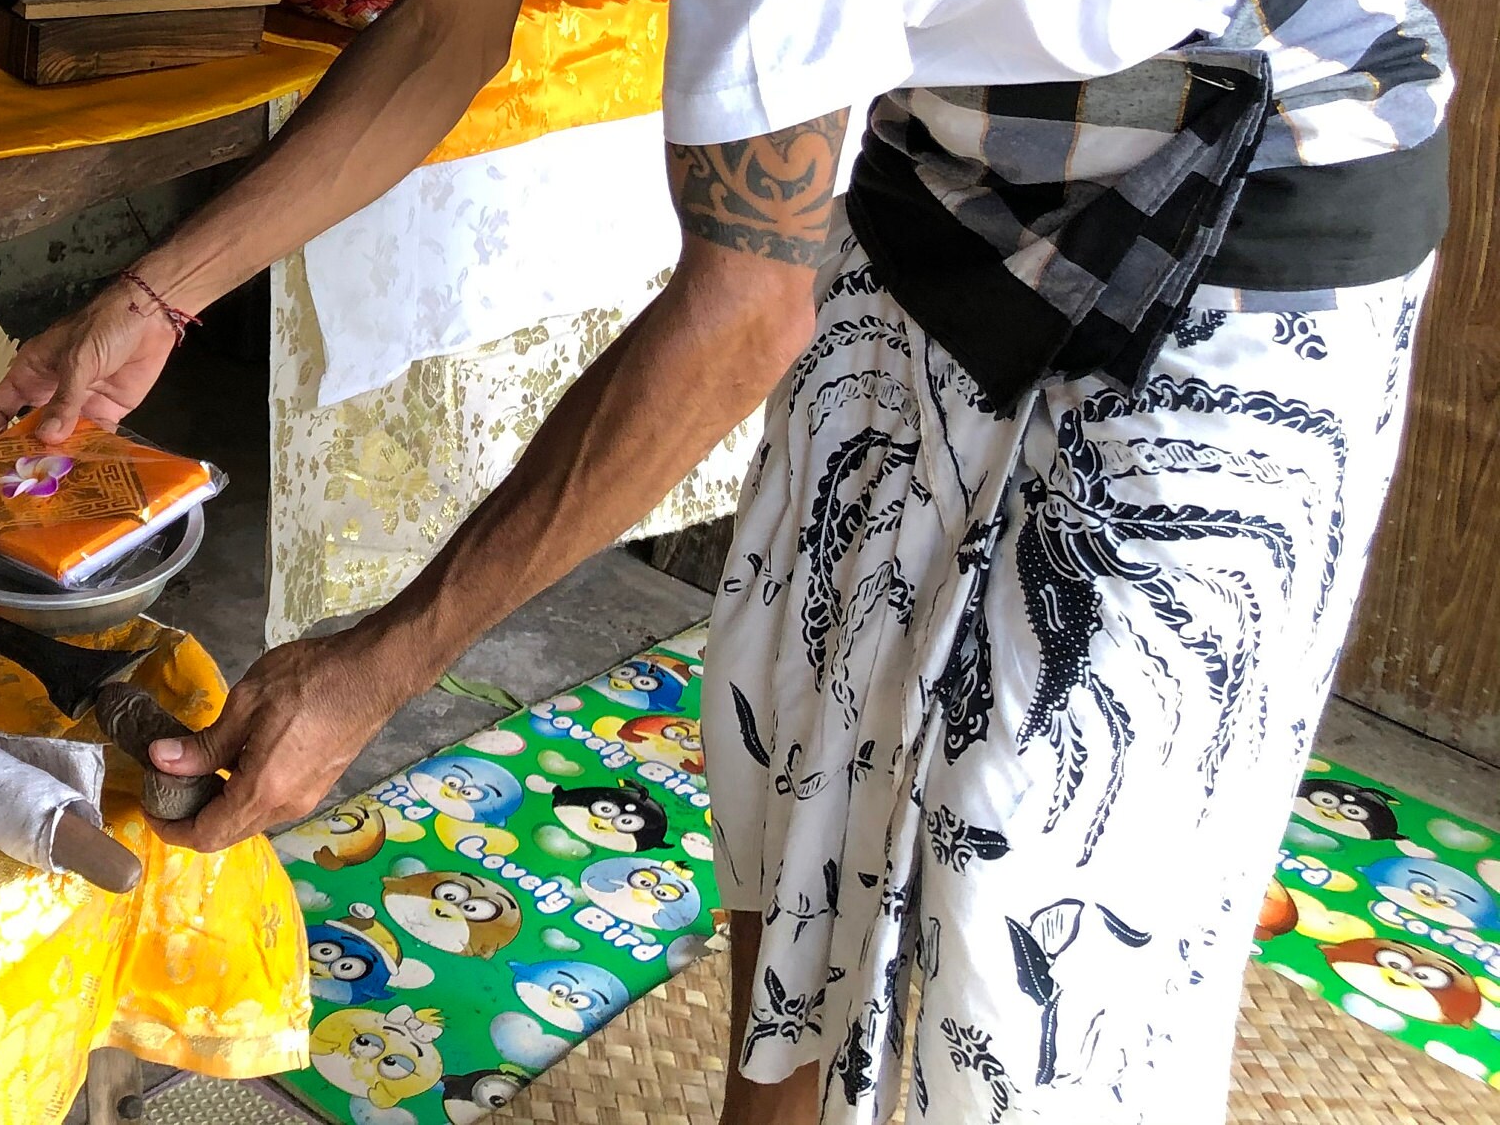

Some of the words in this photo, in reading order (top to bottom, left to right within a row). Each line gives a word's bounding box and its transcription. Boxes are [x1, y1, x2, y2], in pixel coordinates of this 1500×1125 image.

[529, 702, 636, 770] Lovely
[455, 835, 574, 915] Lovely
[572, 906, 667, 962] Bird
